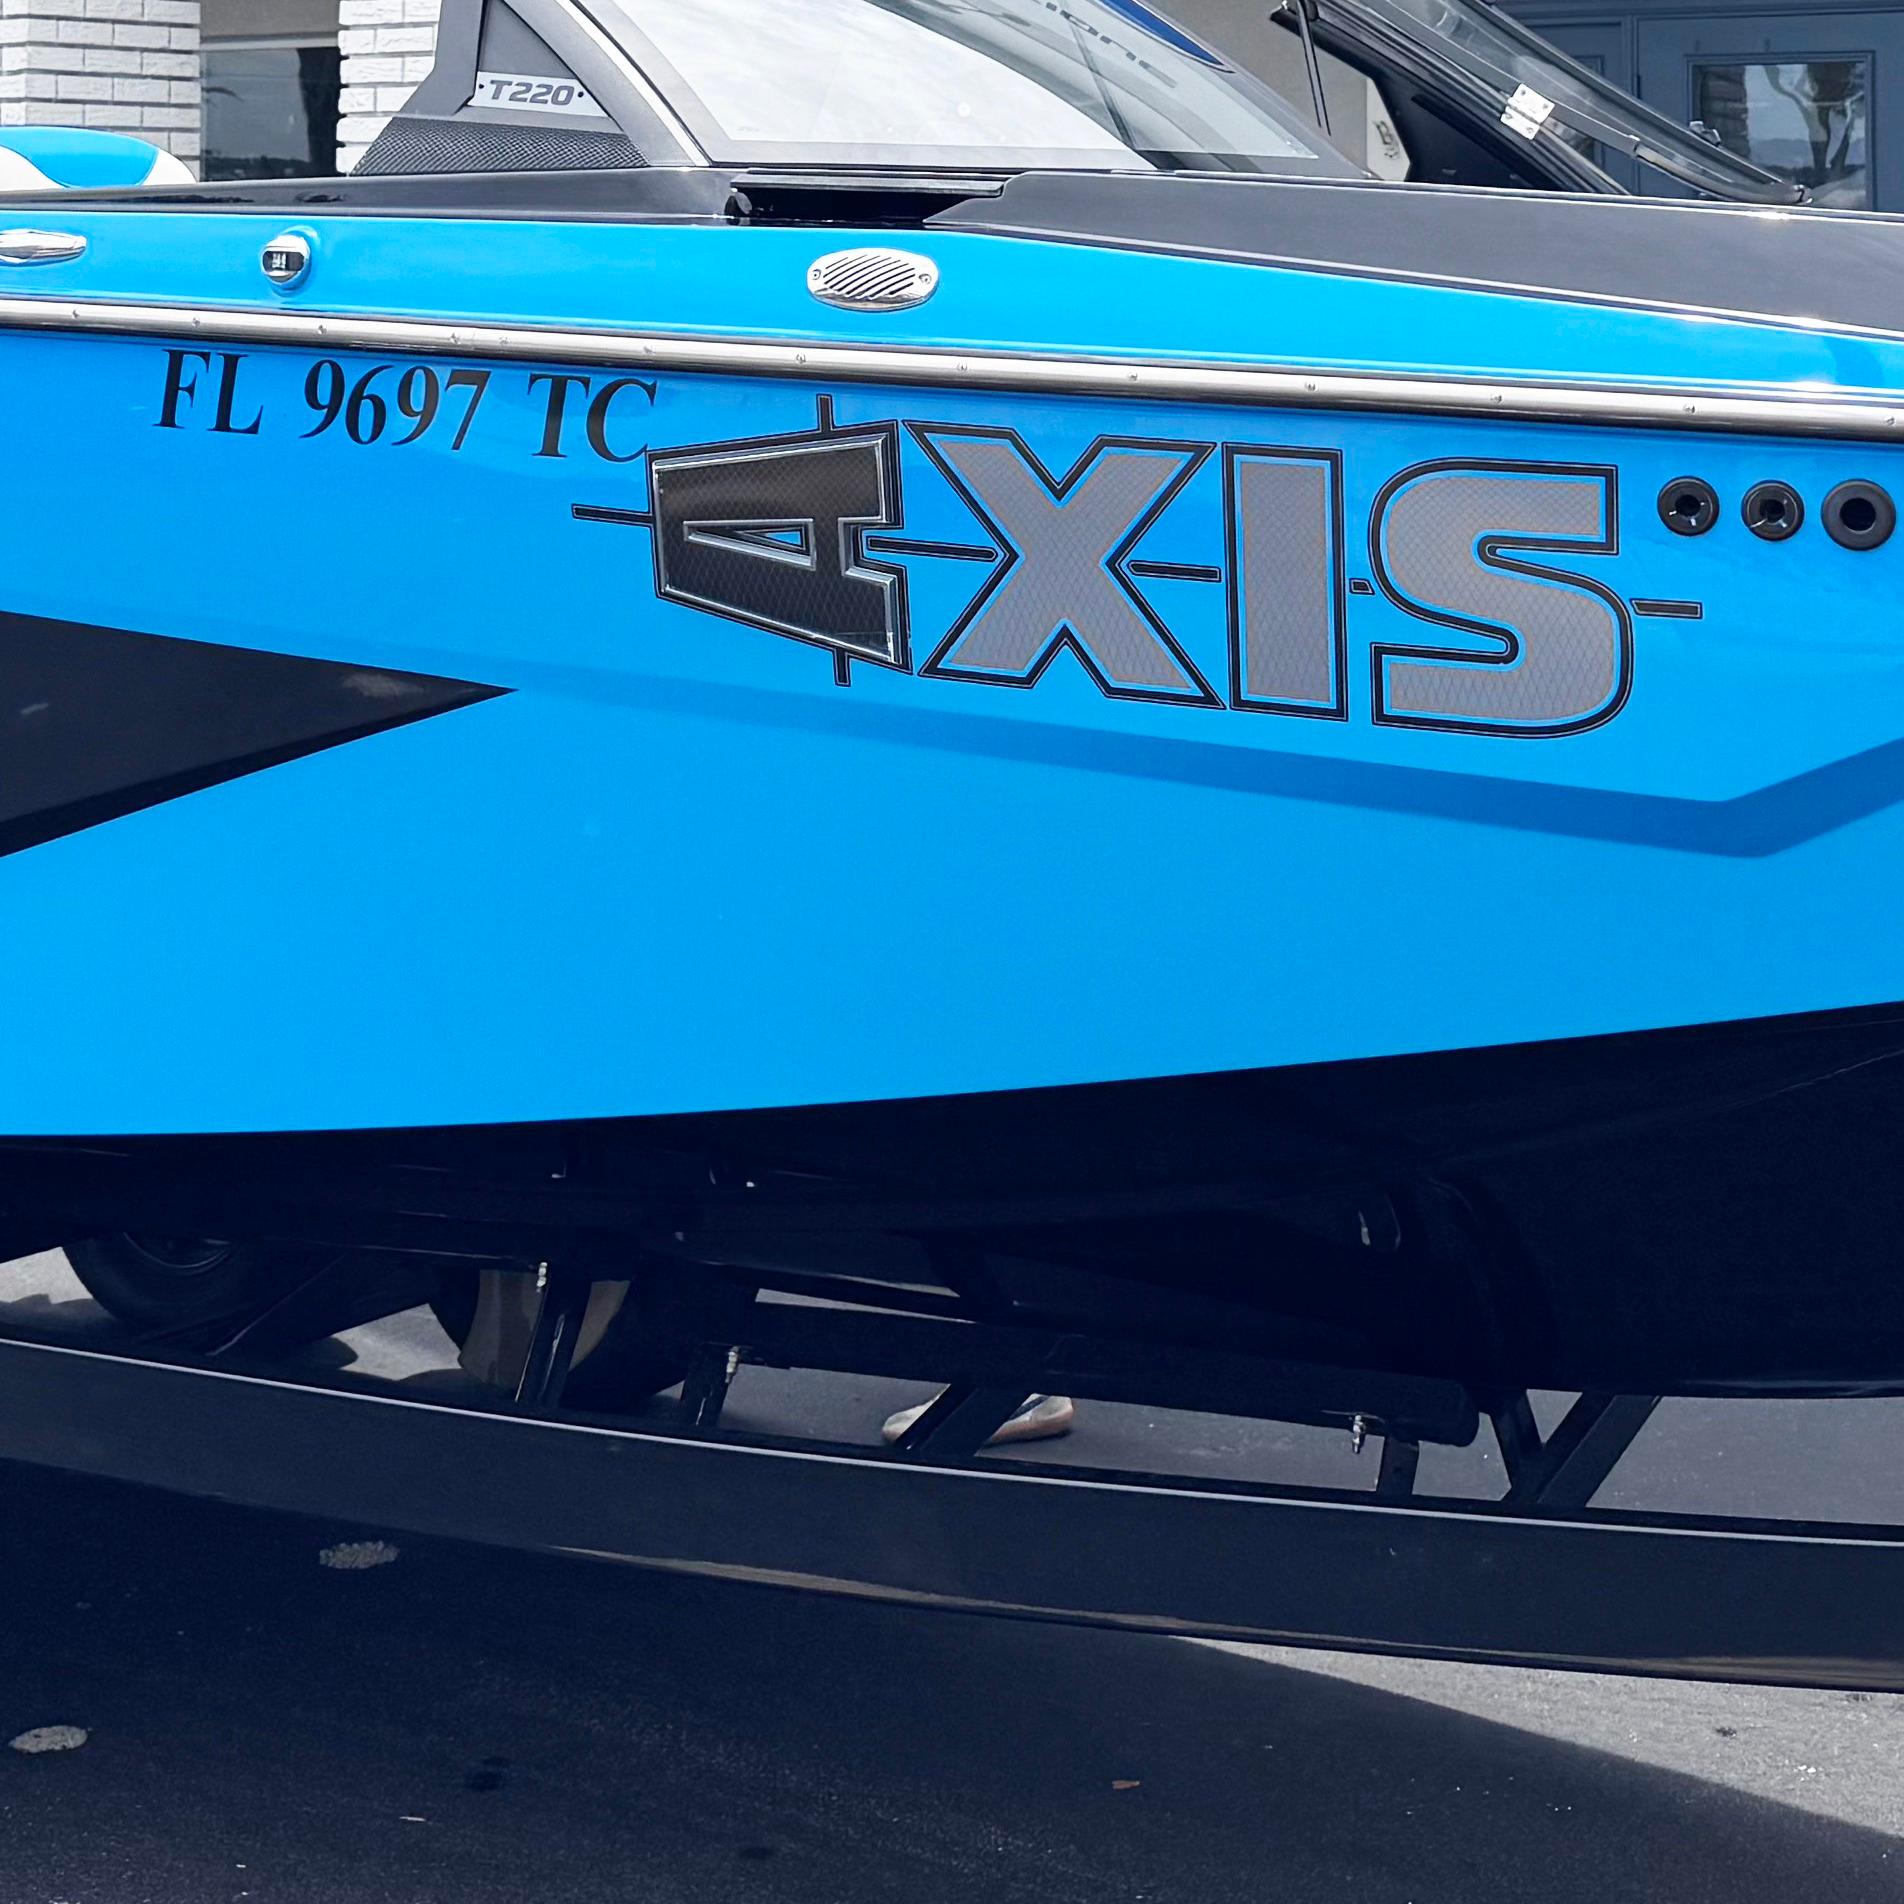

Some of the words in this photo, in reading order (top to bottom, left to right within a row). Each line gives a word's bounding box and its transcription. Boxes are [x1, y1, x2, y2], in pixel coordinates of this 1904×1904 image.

[489, 78, 575, 107] T220
[153, 348, 264, 436] FL
[299, 358, 493, 452] 9697
[527, 372, 659, 463] TC
[645, 418, 1635, 740] AXIS
